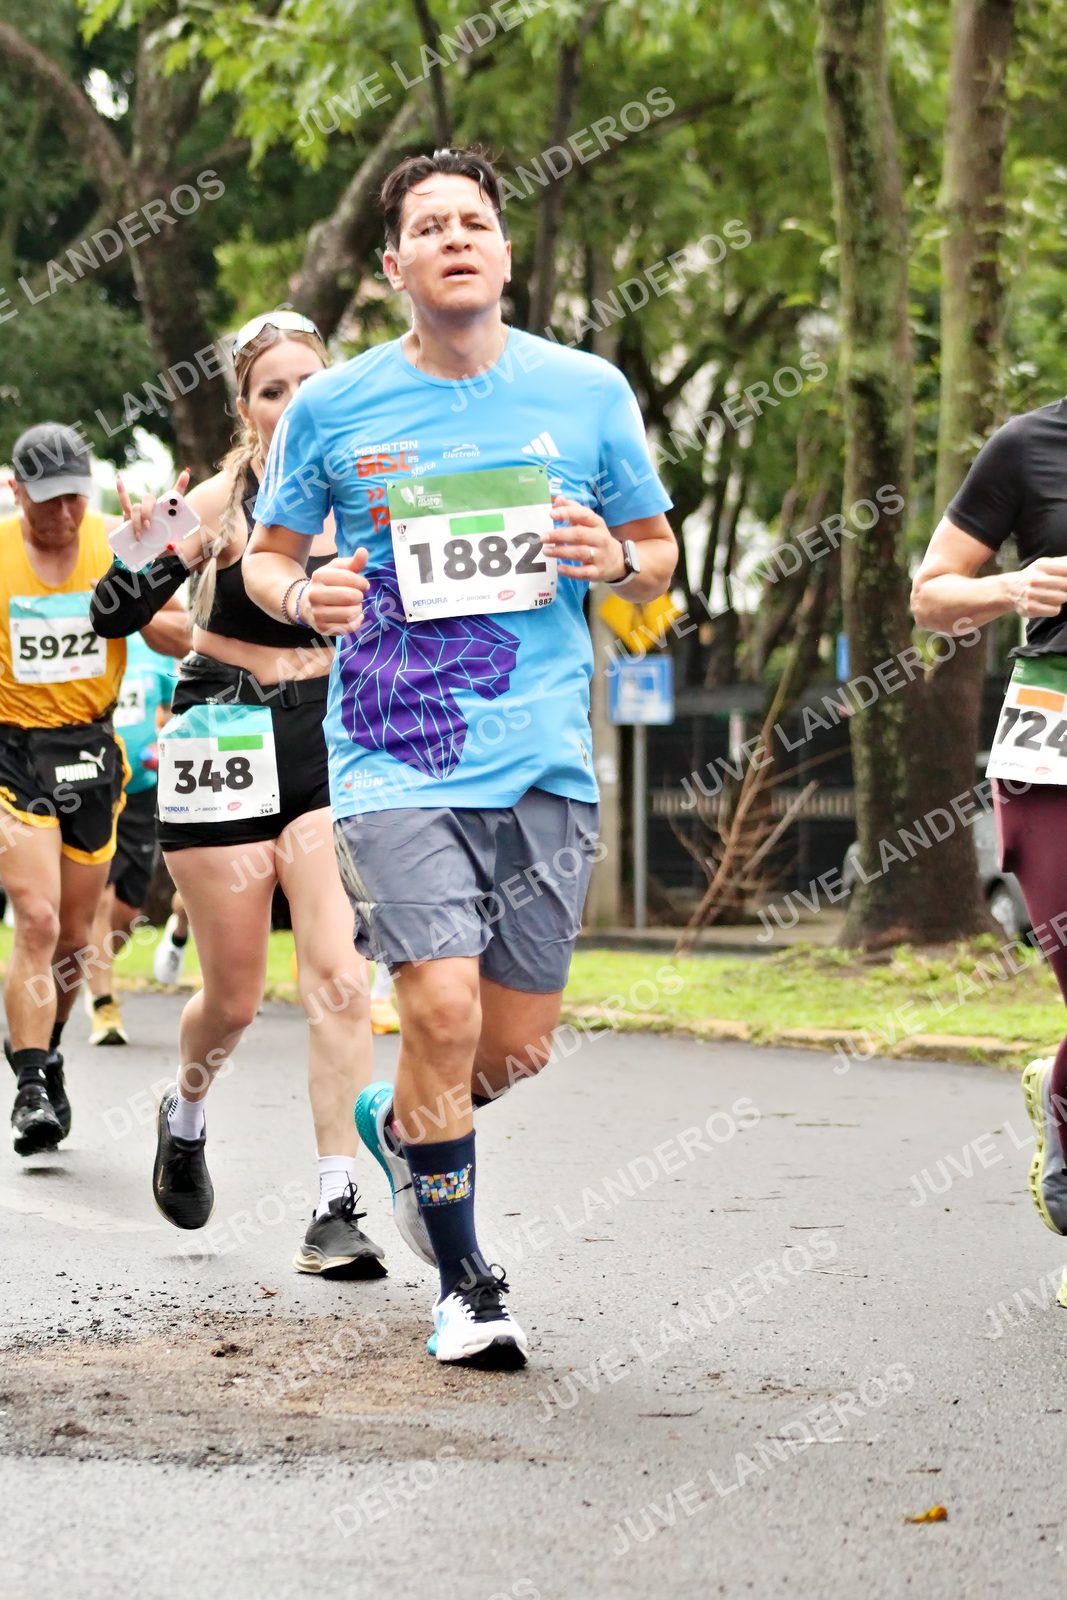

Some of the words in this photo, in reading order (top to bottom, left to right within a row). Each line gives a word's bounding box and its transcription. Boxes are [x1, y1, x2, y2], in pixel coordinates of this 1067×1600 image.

[354, 440, 418, 458] MARATON
[410, 531, 547, 584] 1882
[412, 597, 448, 608] PERDURA
[19, 631, 99, 661] 5922
[55, 762, 98, 783] PUMA
[174, 756, 253, 794] 348
